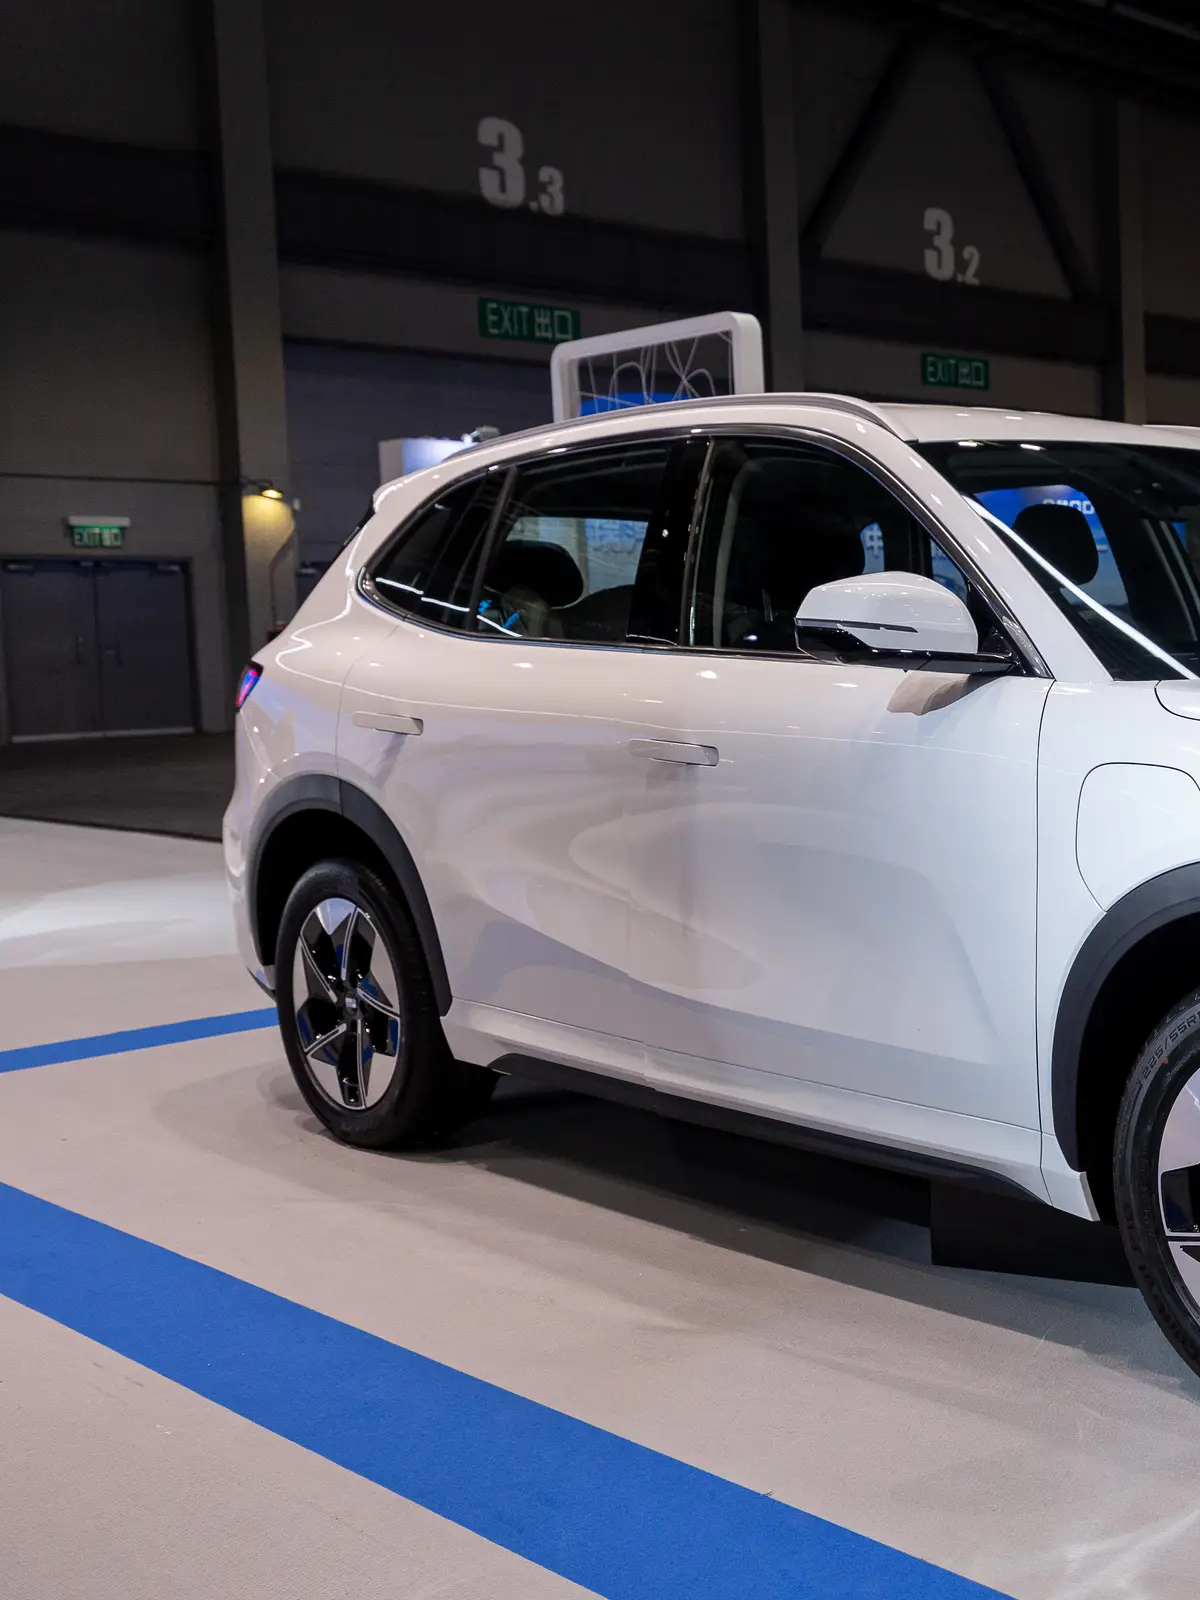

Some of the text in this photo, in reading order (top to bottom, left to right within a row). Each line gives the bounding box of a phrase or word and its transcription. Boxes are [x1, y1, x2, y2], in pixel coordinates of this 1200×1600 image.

[477, 117, 564, 216] 3.3
[923, 207, 981, 286] 3.2
[487, 302, 573, 340] EXIT 出口
[927, 356, 957, 384] EXIT
